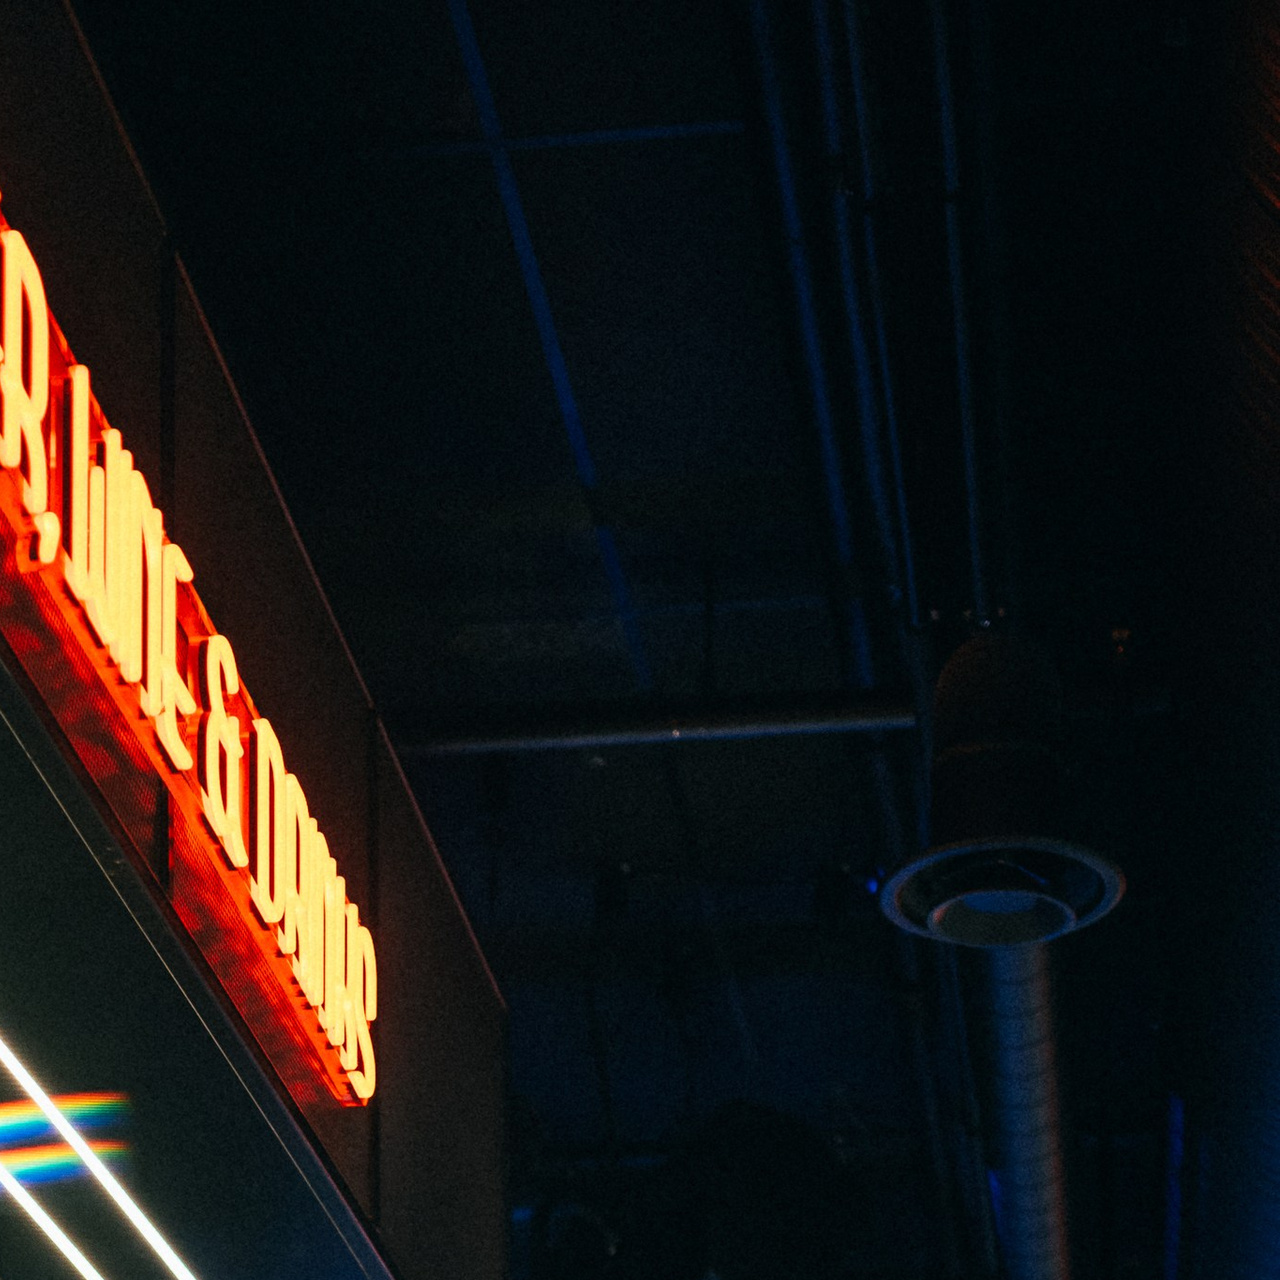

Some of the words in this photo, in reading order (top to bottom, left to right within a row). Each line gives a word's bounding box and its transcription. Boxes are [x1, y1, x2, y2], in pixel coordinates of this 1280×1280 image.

[65, 364, 196, 771] WINE
[200, 634, 250, 868] &
[251, 717, 378, 1099] DRINKS
